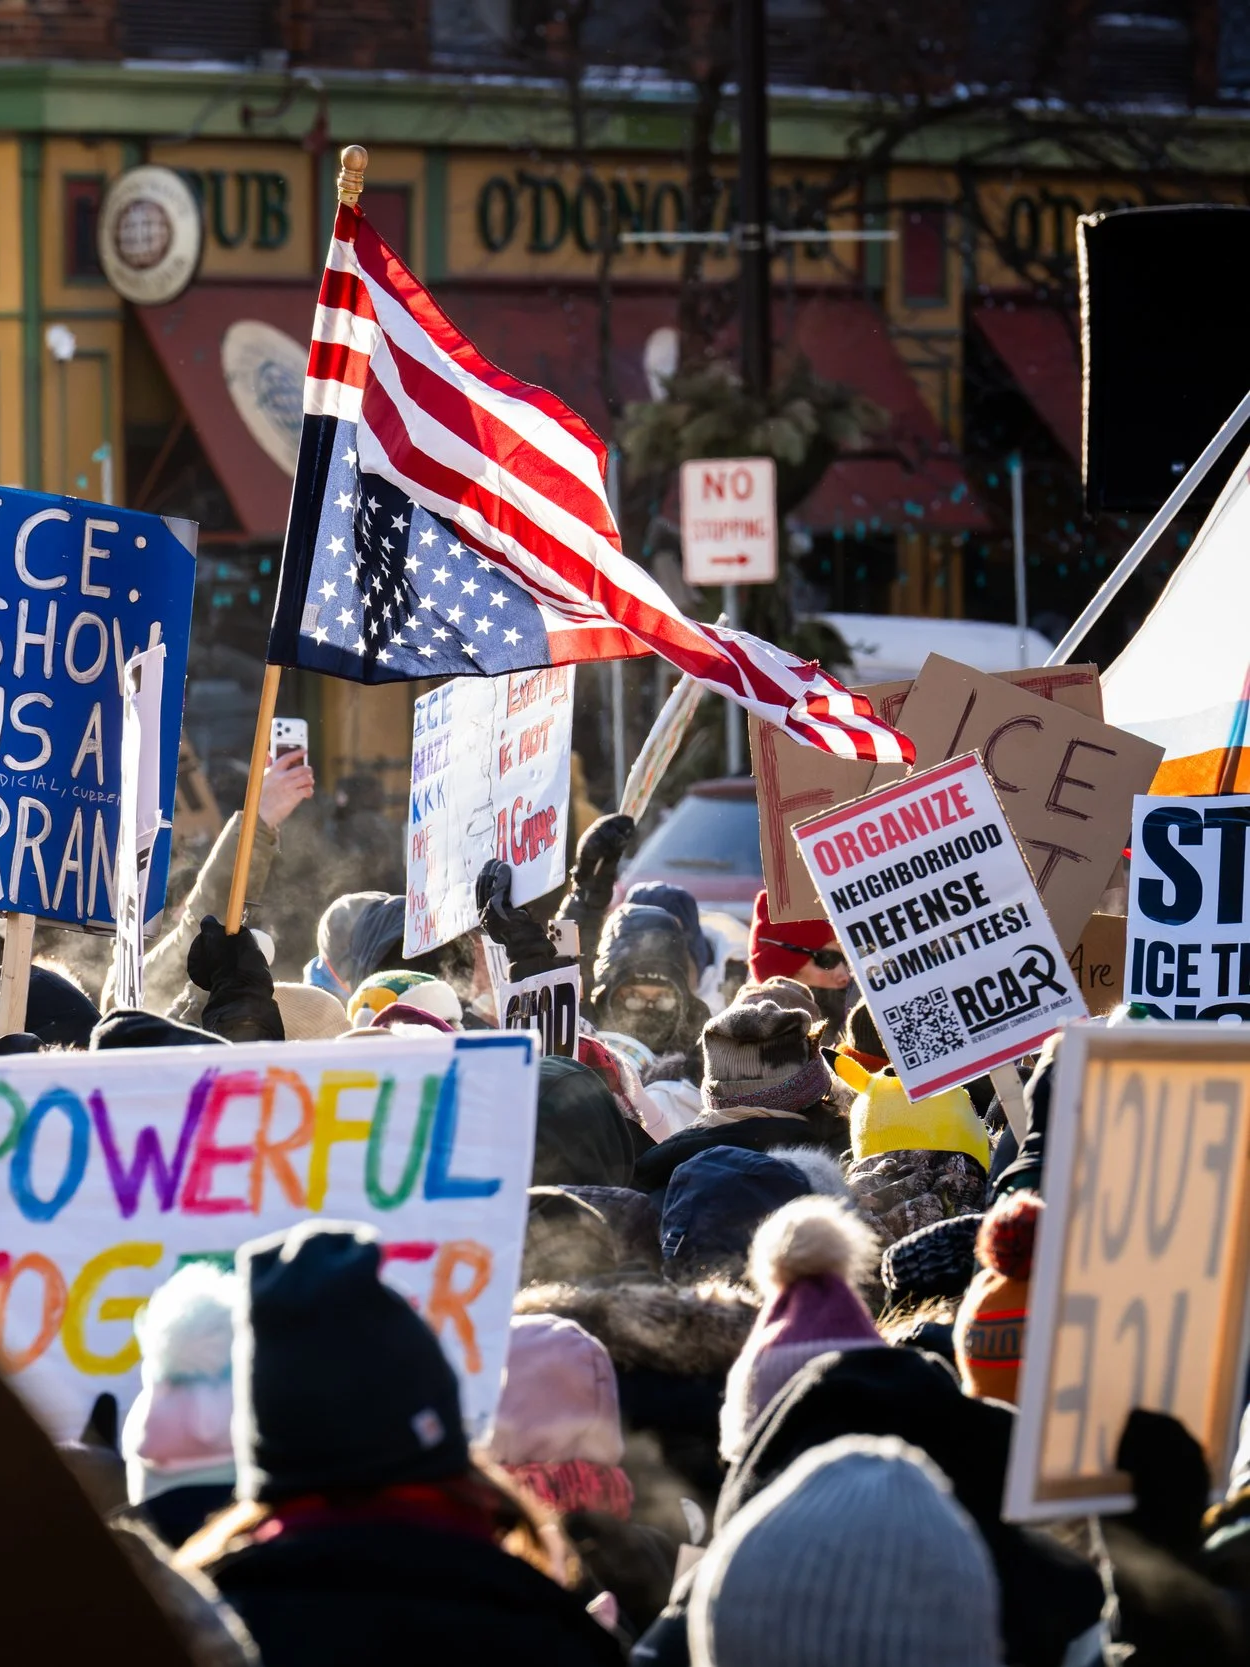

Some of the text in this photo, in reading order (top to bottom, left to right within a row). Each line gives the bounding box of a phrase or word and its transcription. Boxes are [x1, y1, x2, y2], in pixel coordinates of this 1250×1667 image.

[702, 467, 754, 501] NO
[414, 681, 454, 738] ICE
[71, 702, 104, 785] A
[943, 688, 1117, 821] ICE
[412, 774, 446, 825] KKK
[813, 782, 975, 876] ORGANIZE
[412, 824, 433, 863] ARE
[497, 806, 507, 862] A
[830, 823, 1003, 914] NEIGHBORHOOD
[846, 871, 991, 960] DEFENSE
[865, 902, 1032, 992] COMMITTEES!
[1131, 937, 1202, 998] ICE
[951, 966, 1028, 1027] RCA
